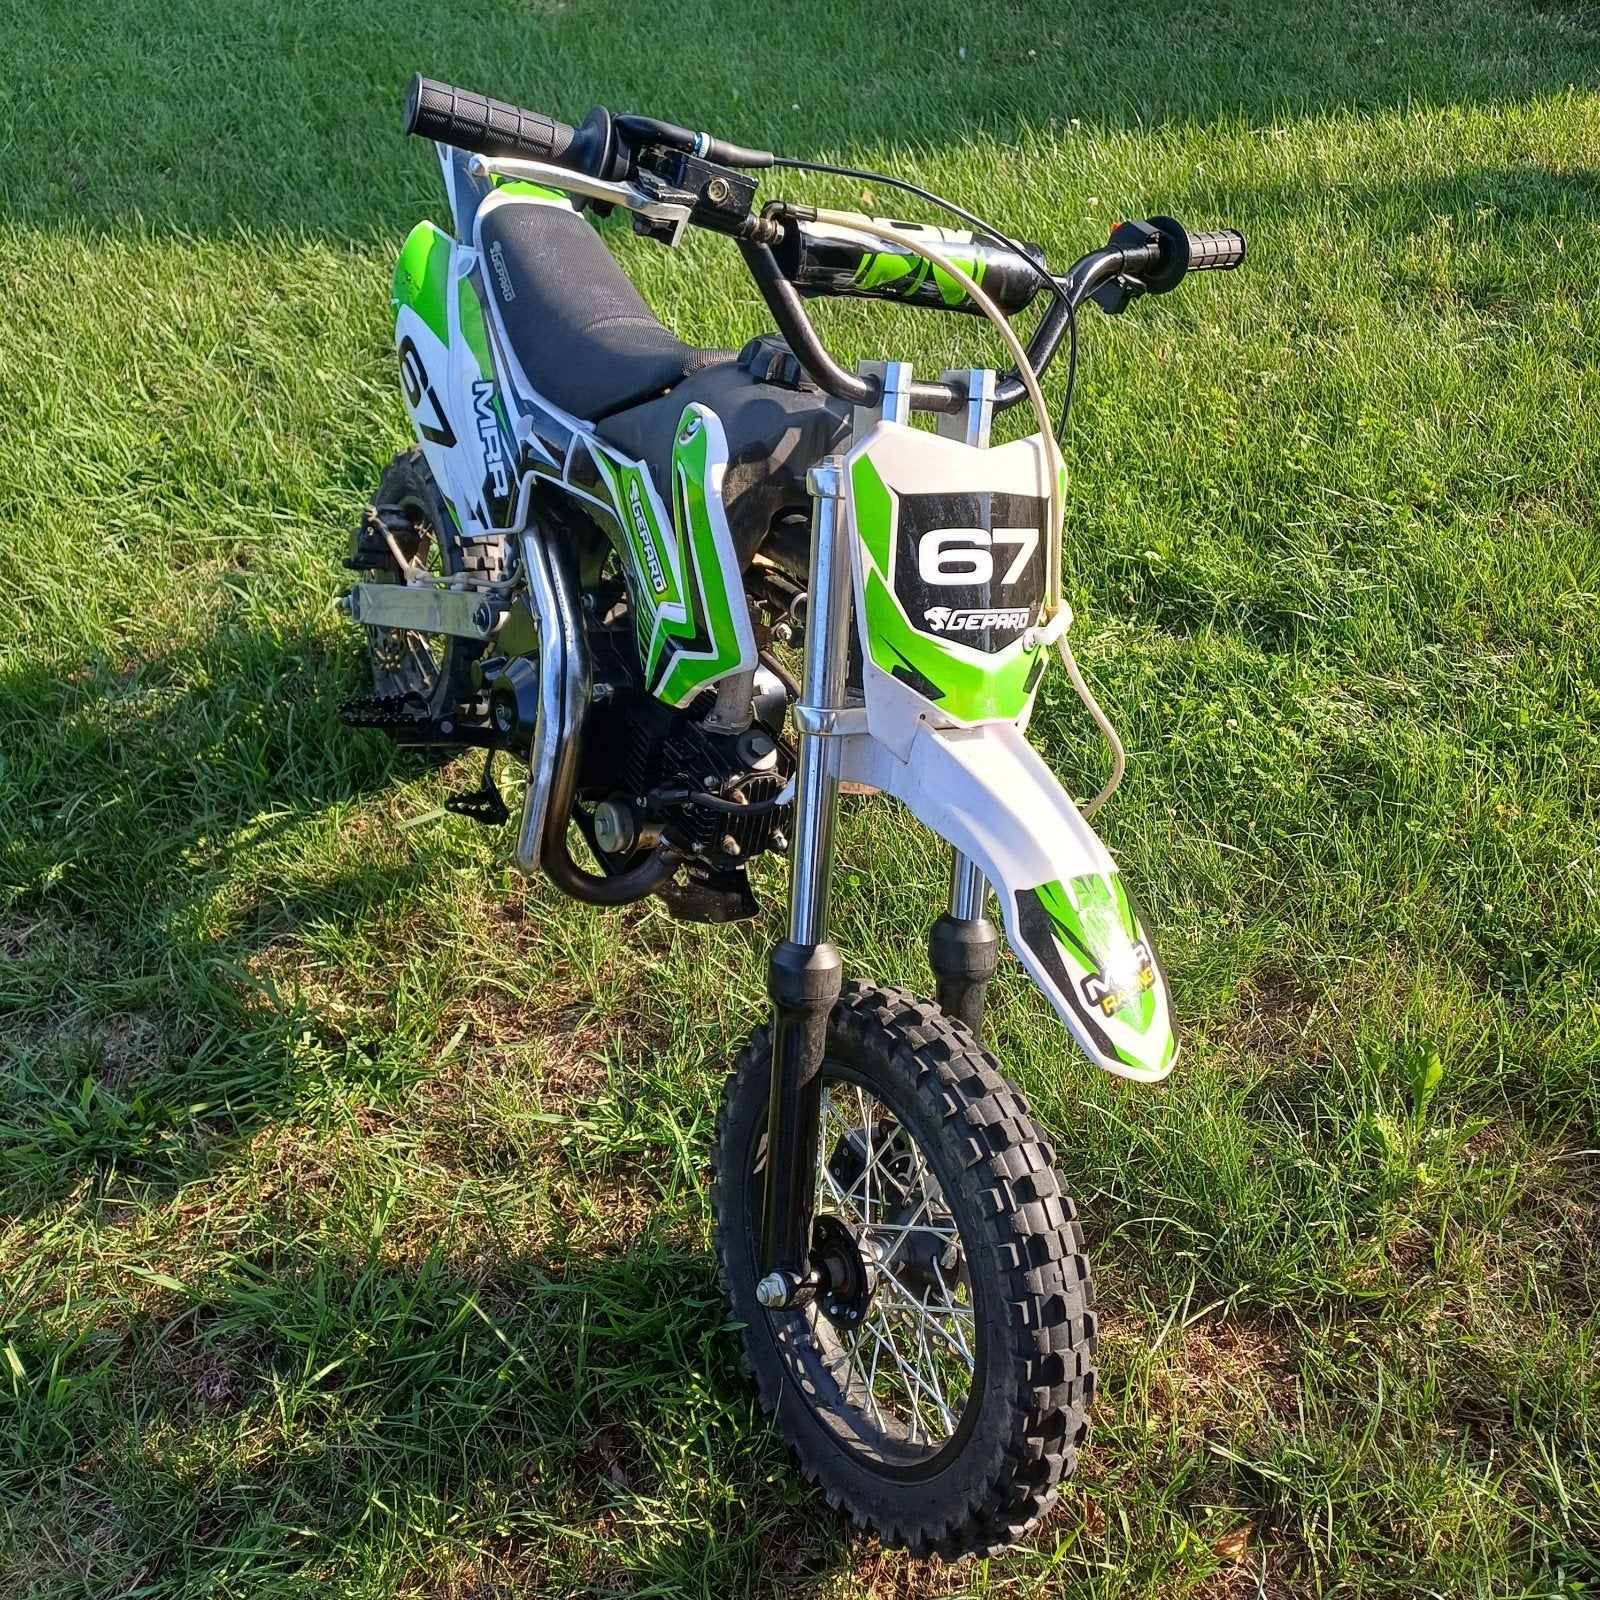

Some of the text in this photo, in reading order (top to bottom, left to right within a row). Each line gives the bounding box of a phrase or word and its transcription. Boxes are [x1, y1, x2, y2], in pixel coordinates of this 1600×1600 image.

[490, 252, 516, 302] GEPARD
[400, 334, 458, 449] 67
[473, 380, 509, 498] MRR
[631, 500, 668, 592] GEPARD
[918, 528, 1040, 586] 67
[945, 607, 1031, 632] GEPARD
